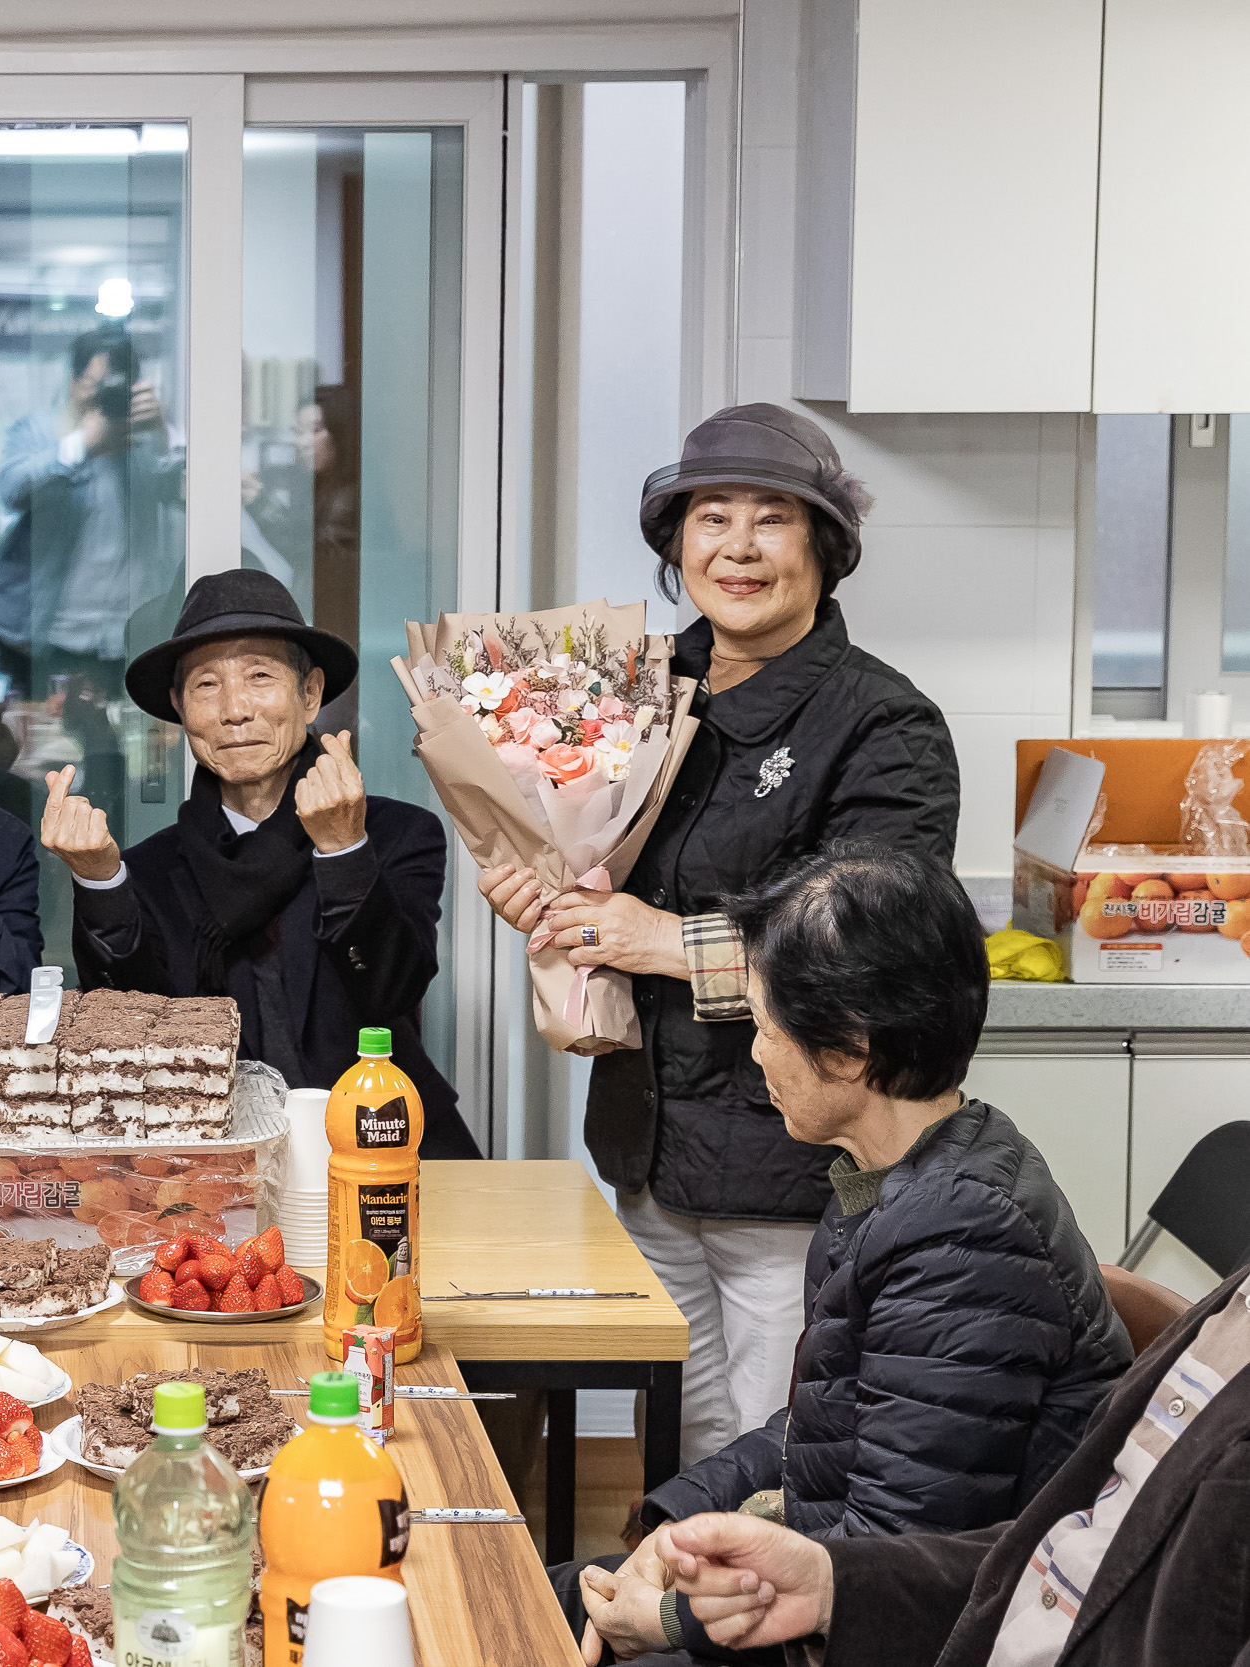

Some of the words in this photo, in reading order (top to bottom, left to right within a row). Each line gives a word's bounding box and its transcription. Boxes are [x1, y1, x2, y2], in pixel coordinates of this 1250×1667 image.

[1138, 900, 1228, 925] 비가림감귤
[360, 1119, 406, 1131] Minute
[366, 1130, 400, 1143] Maid
[370, 1216, 386, 1226] 아연
[386, 1216, 402, 1226] 풍부
